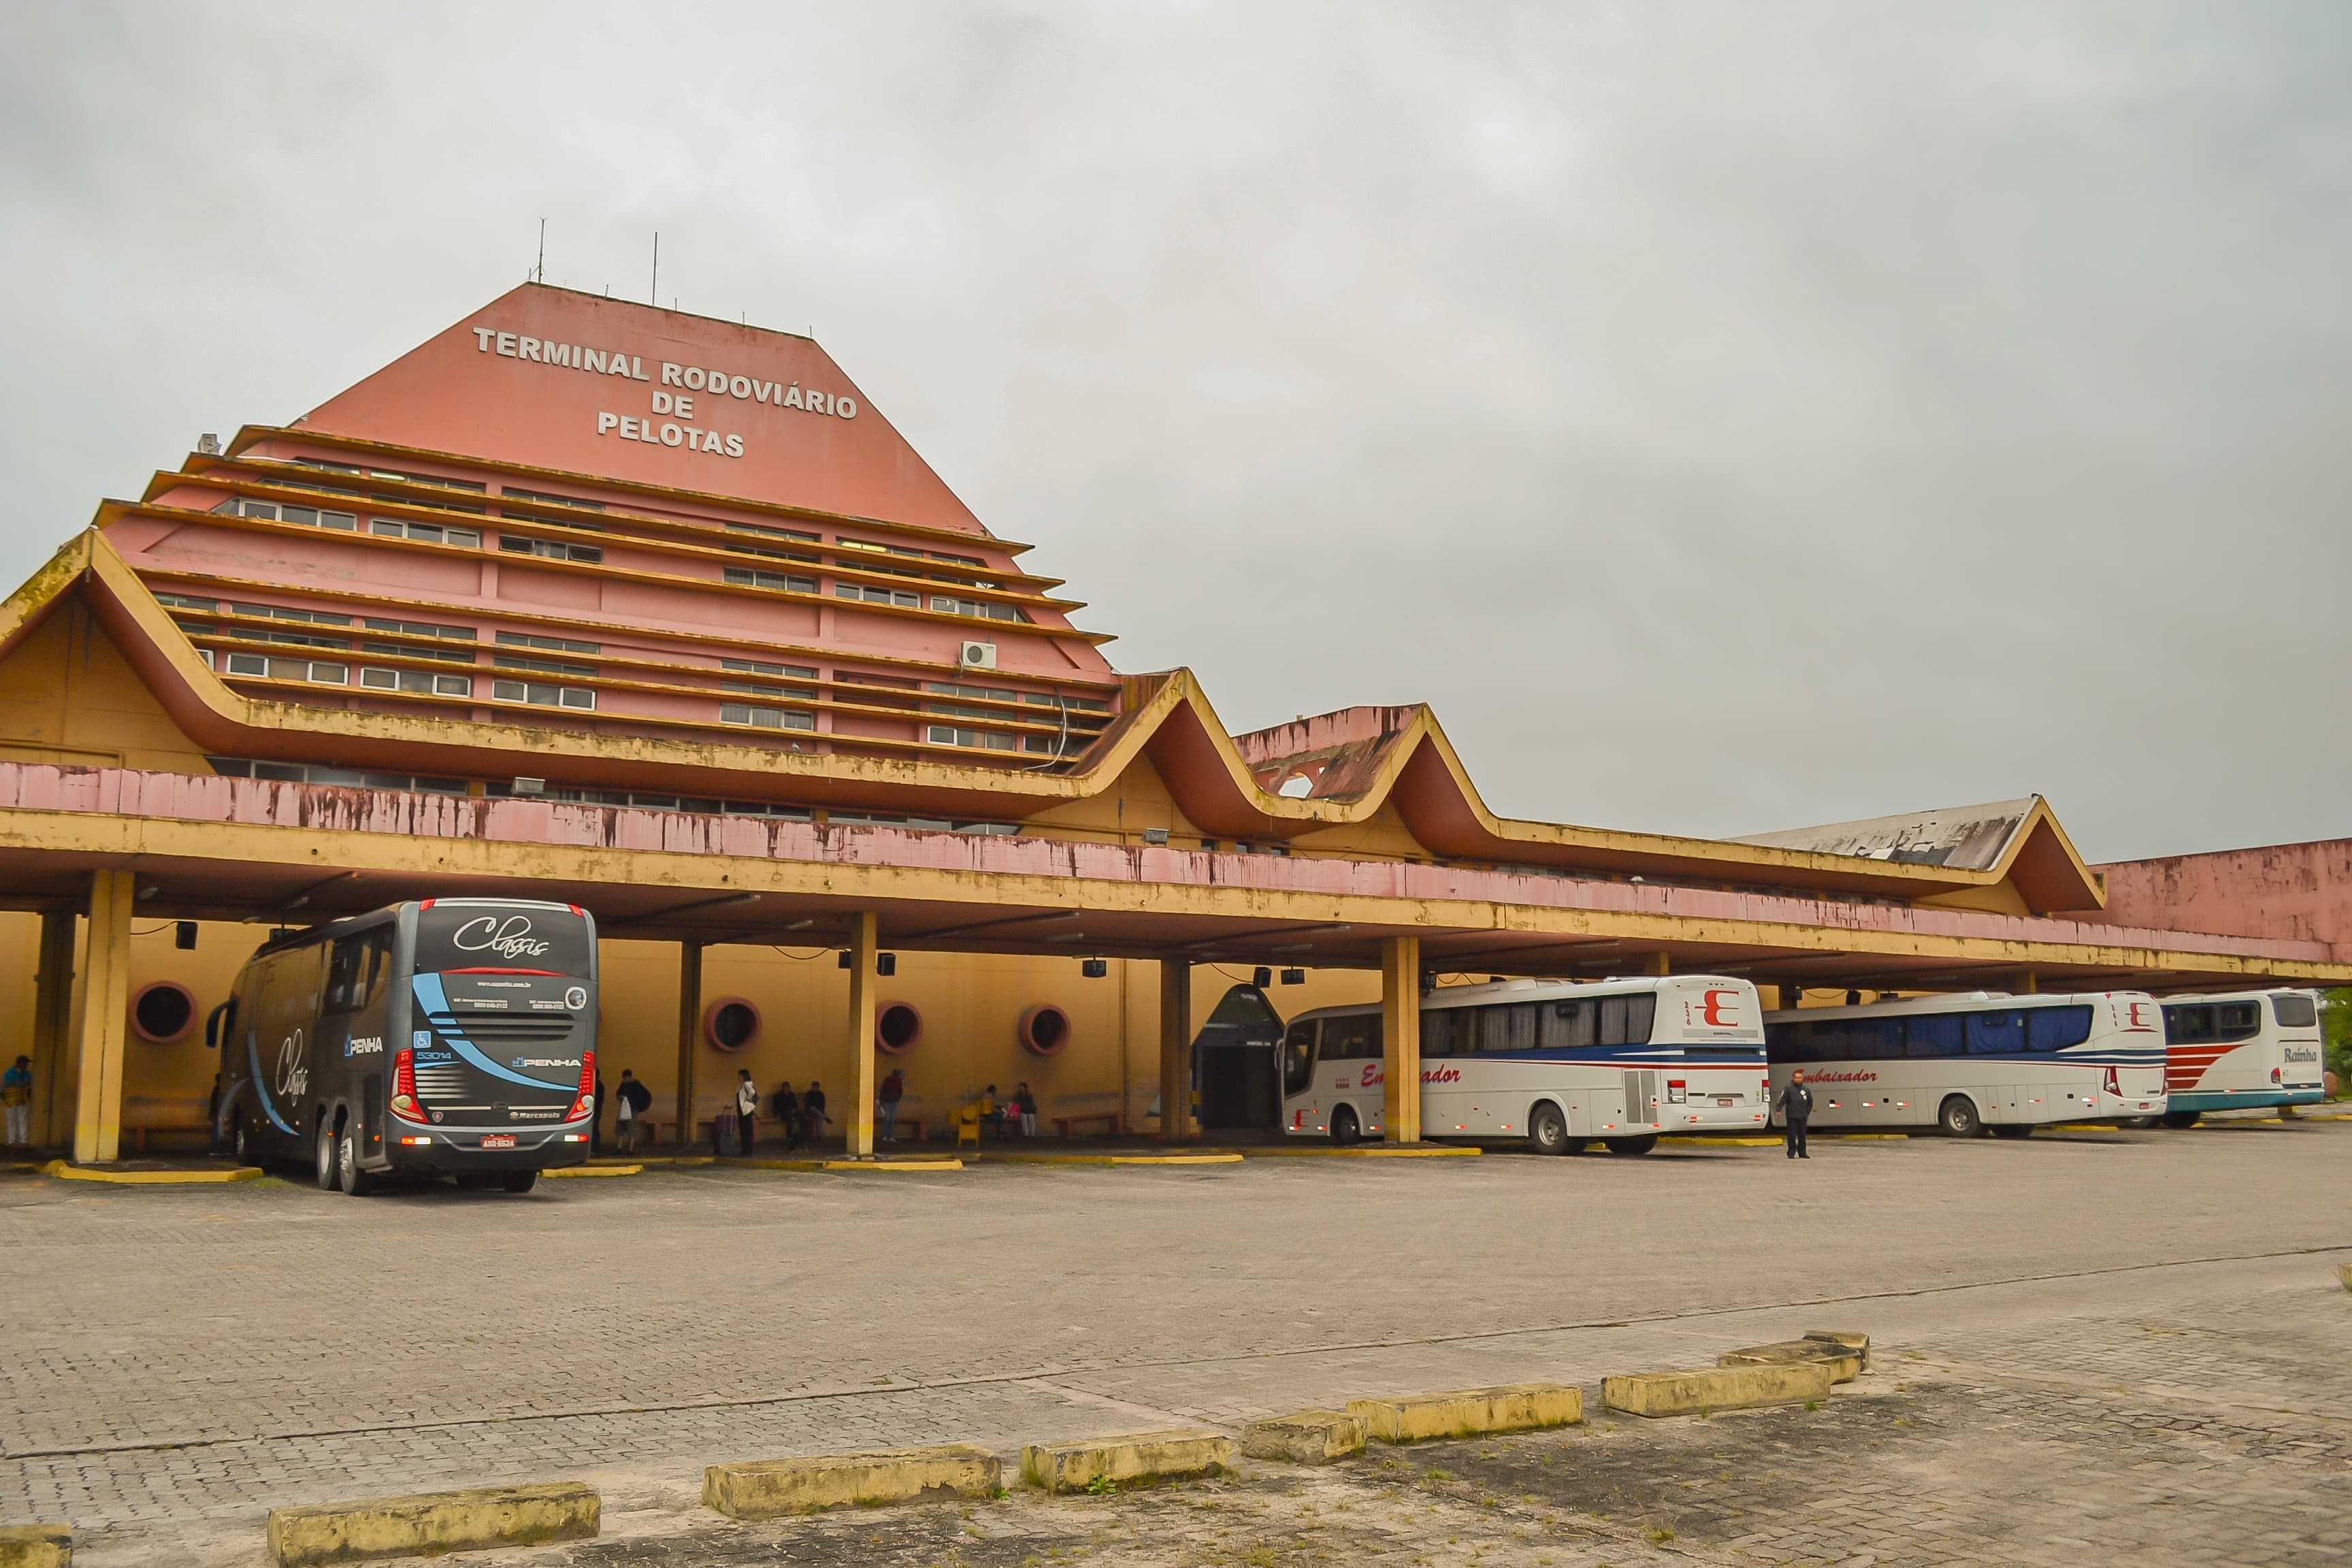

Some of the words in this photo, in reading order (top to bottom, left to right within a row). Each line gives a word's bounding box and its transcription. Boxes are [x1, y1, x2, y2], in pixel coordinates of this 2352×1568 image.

[472, 327, 649, 381] TERMINAL
[662, 362, 858, 419] RODOVIÁRIO
[651, 390, 693, 419] DE
[598, 411, 745, 458] PELOTAS
[453, 915, 550, 959] Classis
[350, 1036, 383, 1055] PENHA
[416, 1051, 452, 1060] 53014
[2284, 1047, 2317, 1063] Rainha
[523, 1058, 583, 1067] PENHA
